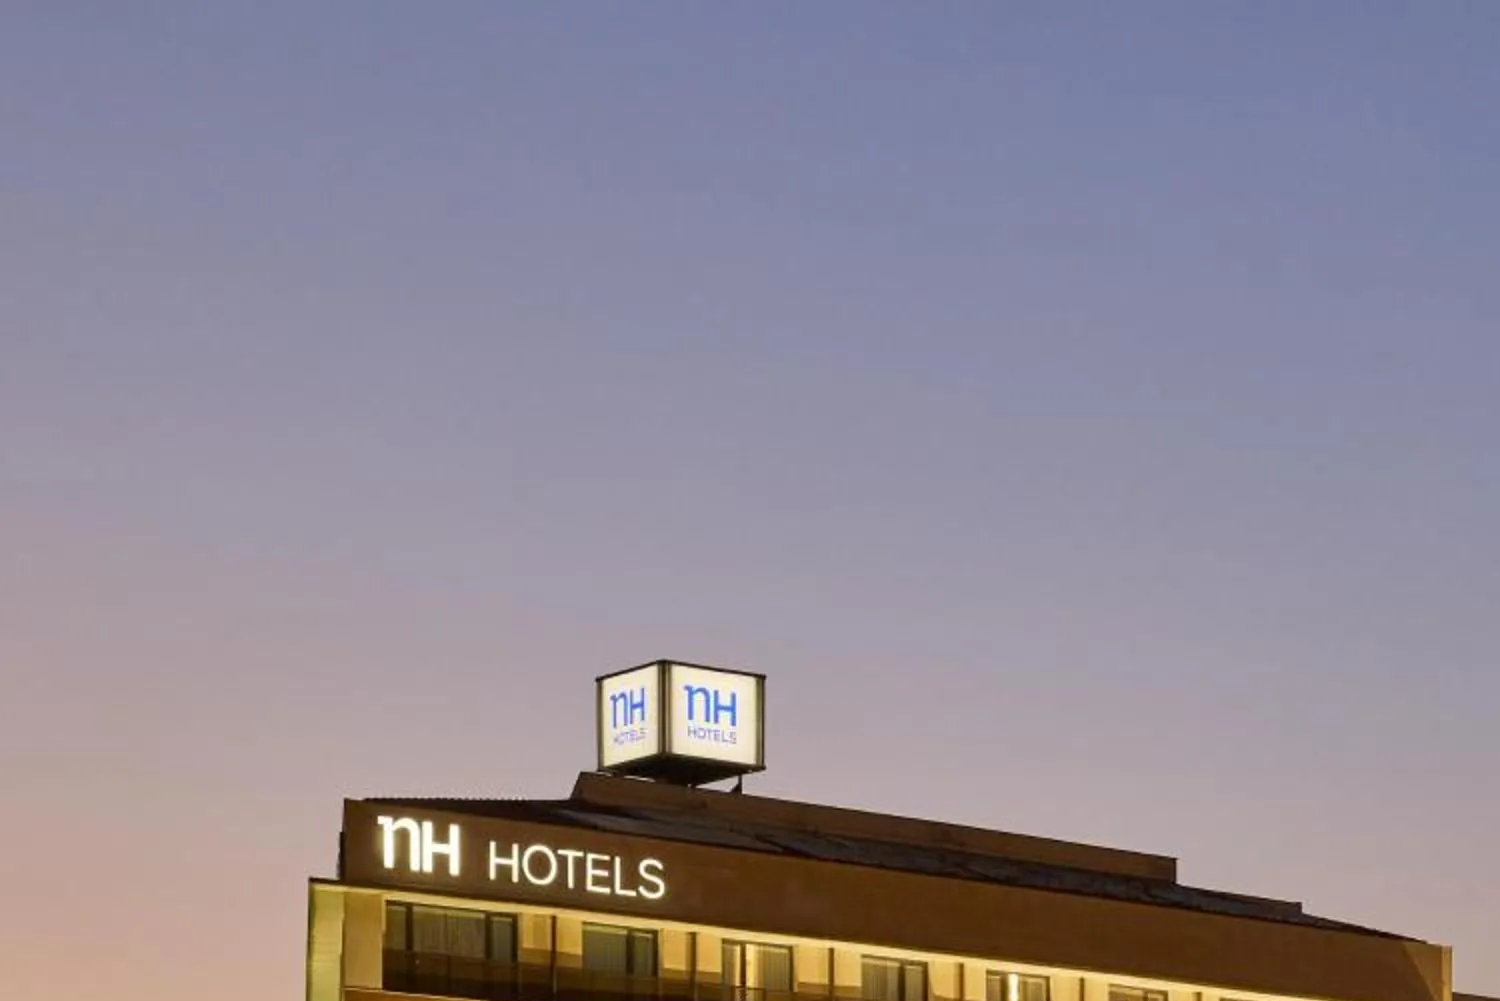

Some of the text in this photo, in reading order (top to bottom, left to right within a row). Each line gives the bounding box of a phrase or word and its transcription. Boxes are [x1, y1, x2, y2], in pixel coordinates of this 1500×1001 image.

[683, 684, 737, 727] nH
[687, 725, 737, 745] HOTELS
[377, 815, 666, 900] nH HOTELS
